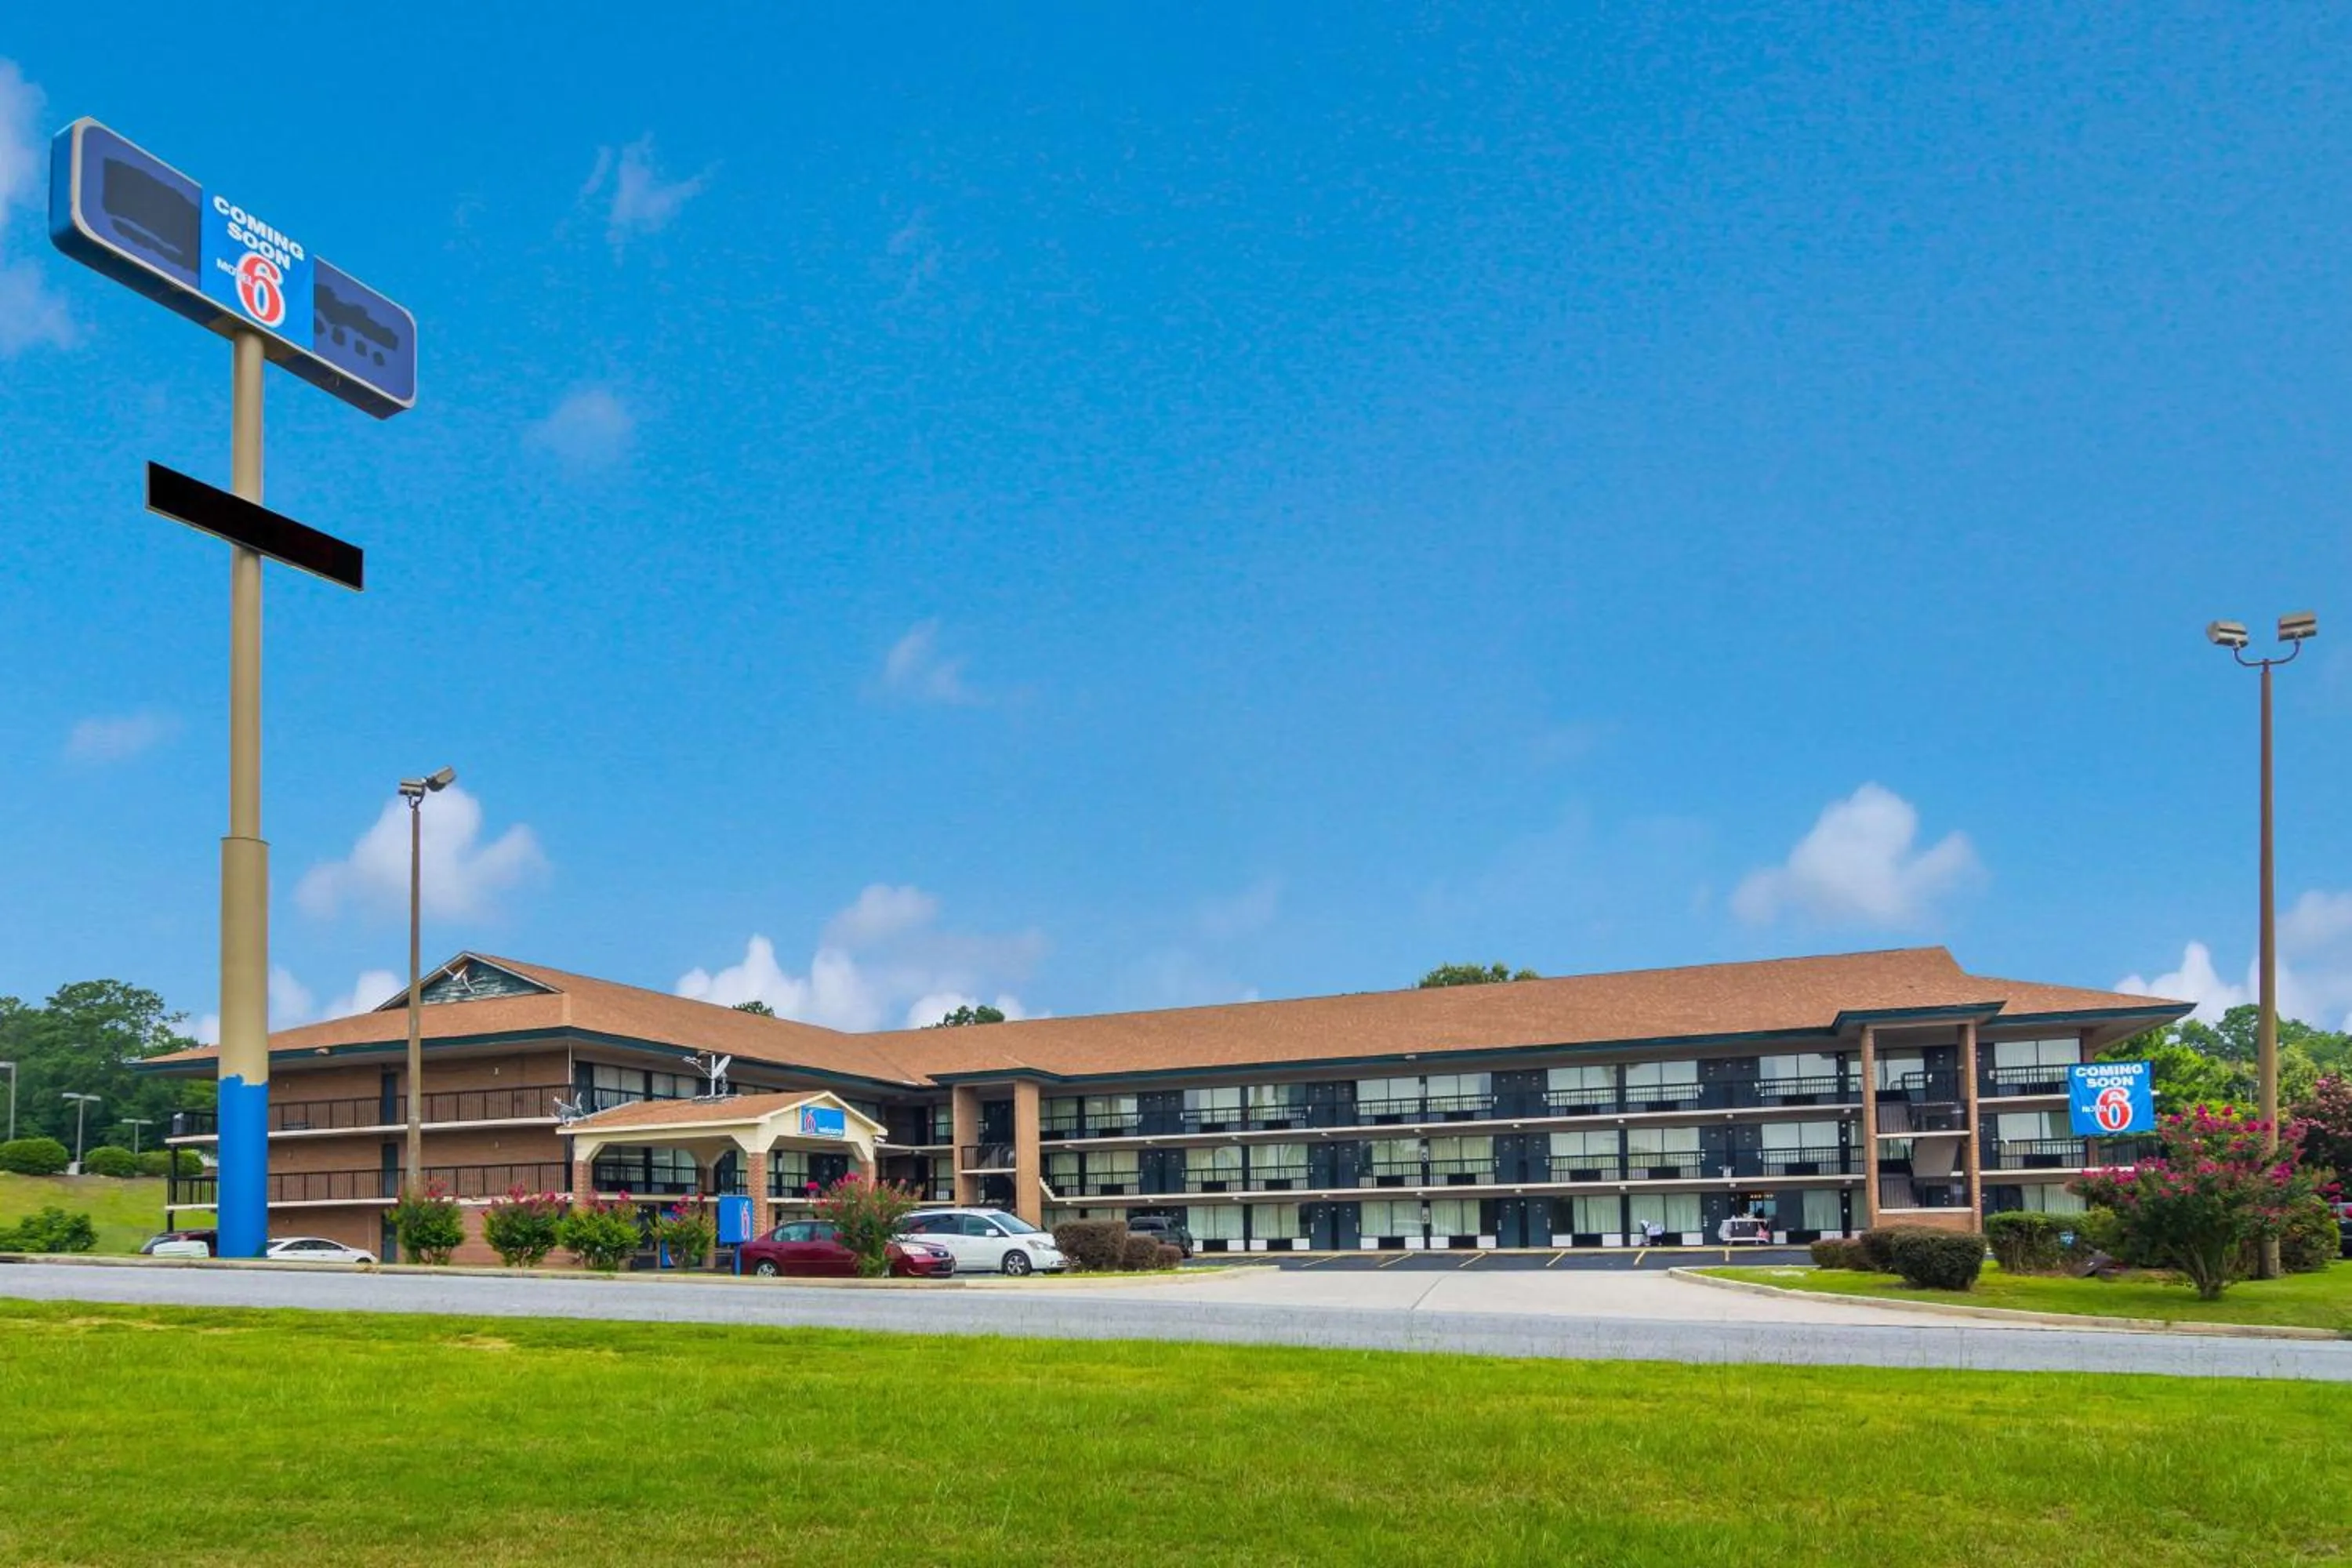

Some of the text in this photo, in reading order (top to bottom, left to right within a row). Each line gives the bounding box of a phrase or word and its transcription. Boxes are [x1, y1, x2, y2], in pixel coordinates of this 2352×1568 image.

[212, 195, 305, 261] COMING
[227, 221, 291, 270] SOON
[237, 251, 285, 328] 6
[2075, 1063, 2143, 1077] COMING
[2086, 1076, 2134, 1088] SOON
[2096, 1087, 2132, 1131] 6
